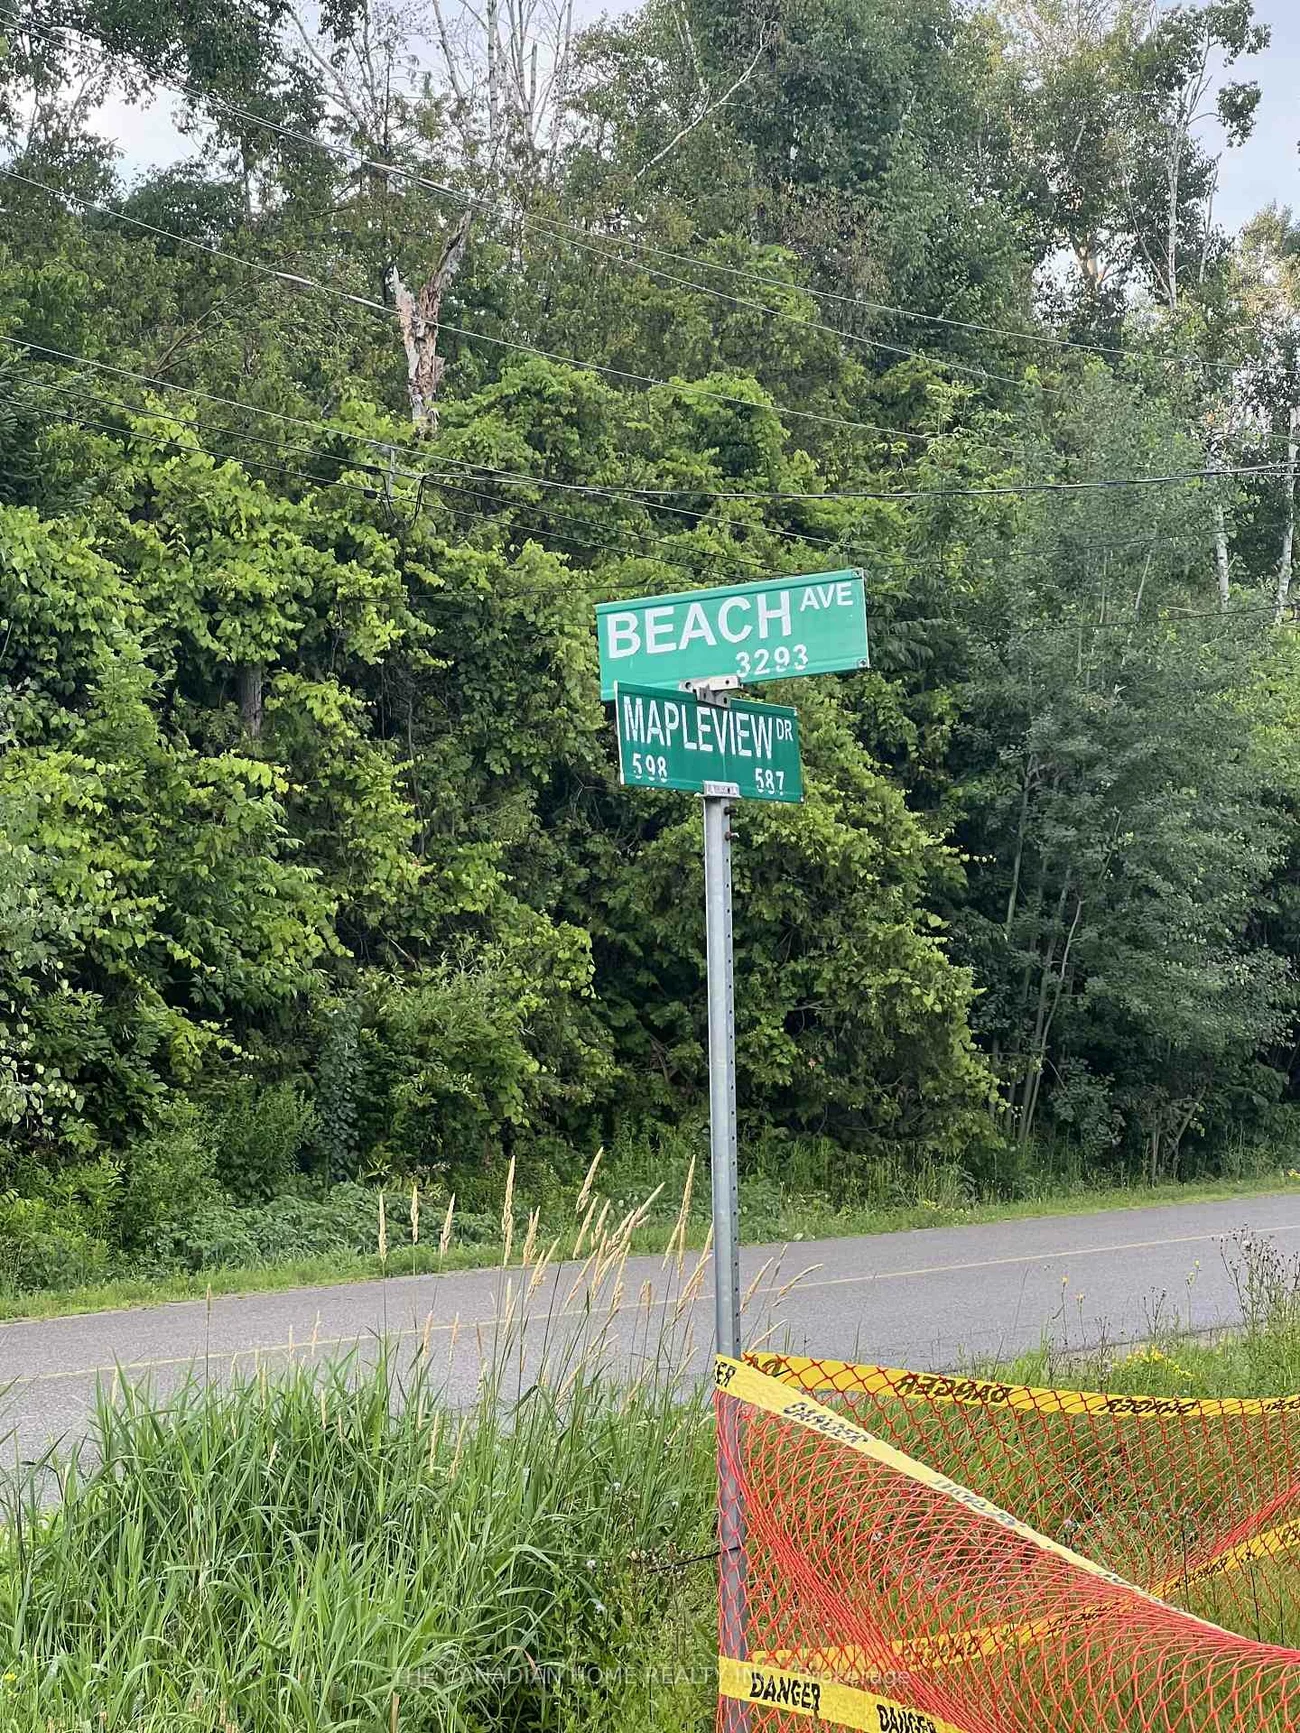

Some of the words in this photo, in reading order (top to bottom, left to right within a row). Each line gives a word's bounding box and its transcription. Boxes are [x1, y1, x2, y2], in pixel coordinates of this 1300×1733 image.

[606, 590, 792, 659] BEACH
[800, 582, 854, 612] AVE
[735, 643, 809, 678] 3293
[623, 696, 773, 759] MAPLEVIEW
[776, 719, 794, 742] DR
[632, 752, 668, 783] 598
[754, 767, 785, 795] 587
[715, 1360, 737, 1388] ER
[749, 1672, 821, 1711] DANGER
